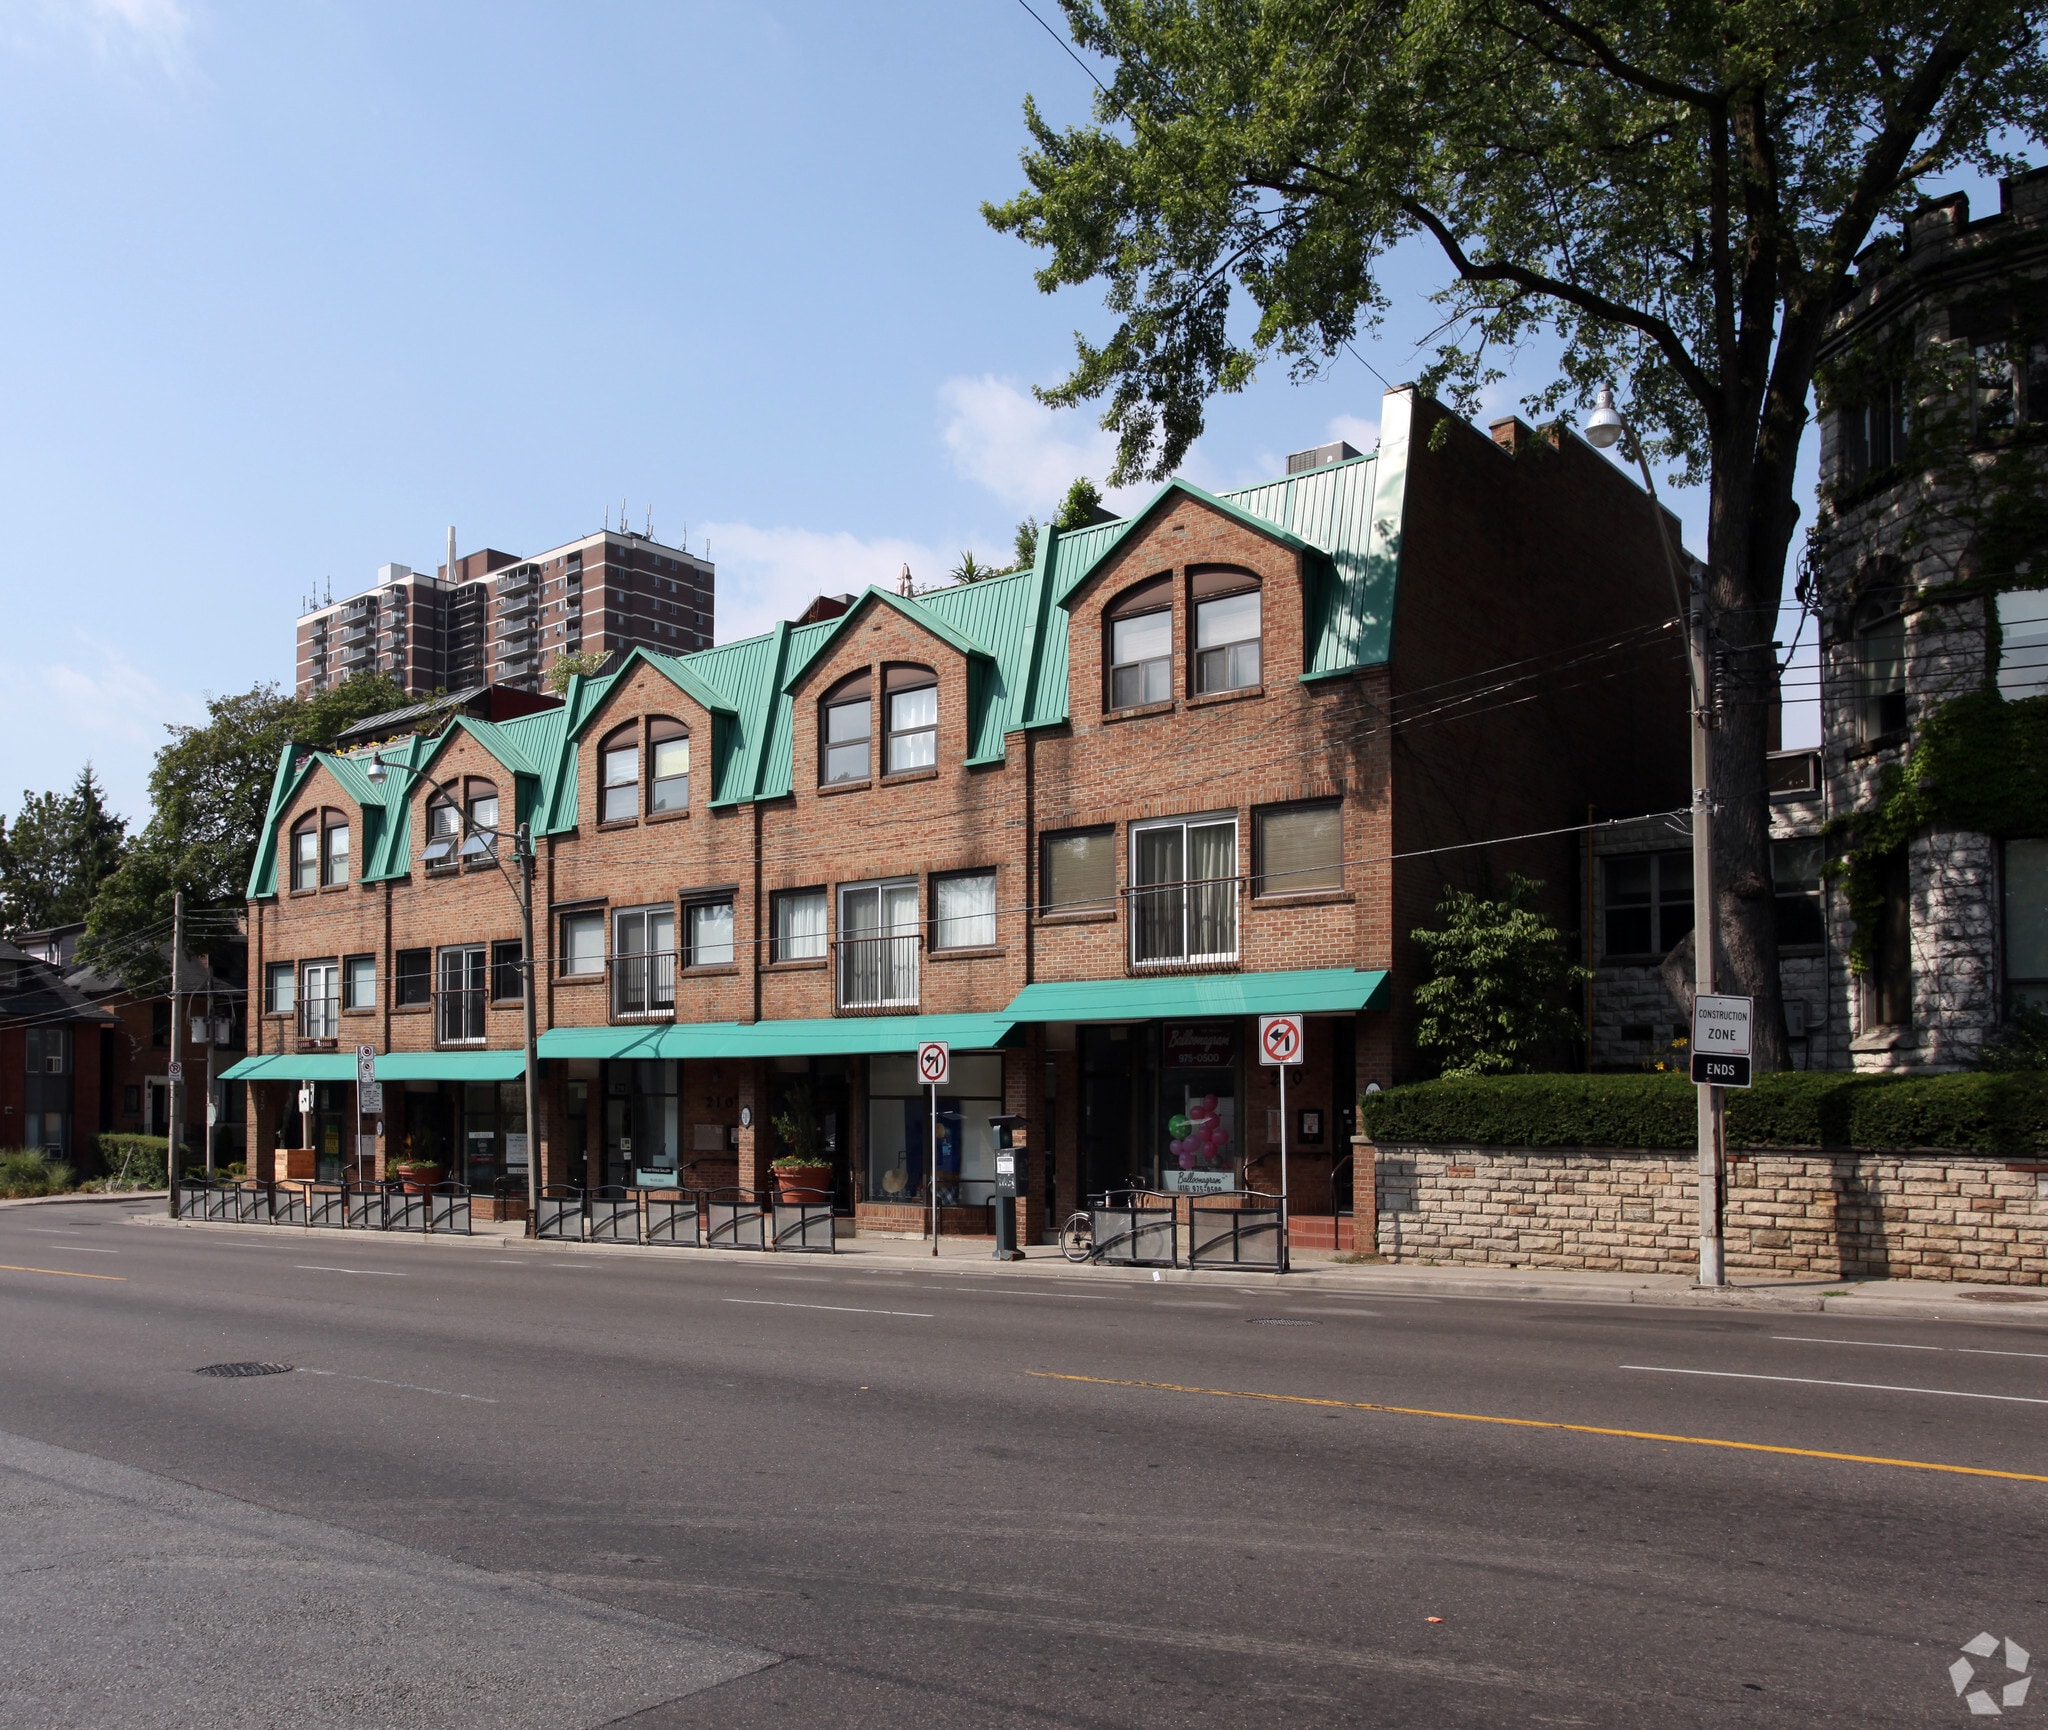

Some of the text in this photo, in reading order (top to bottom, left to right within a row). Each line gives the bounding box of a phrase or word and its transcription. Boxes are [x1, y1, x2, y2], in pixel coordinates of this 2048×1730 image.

[1698, 1009, 1748, 1021] CONSTRUCTION
[1168, 1028, 1230, 1052] Balloonagram
[1708, 1028, 1736, 1041] ZONE
[1178, 1053, 1220, 1063] 975-0500
[1706, 1063, 1735, 1076] ENDS
[1178, 1171, 1222, 1187] Balloonagram
